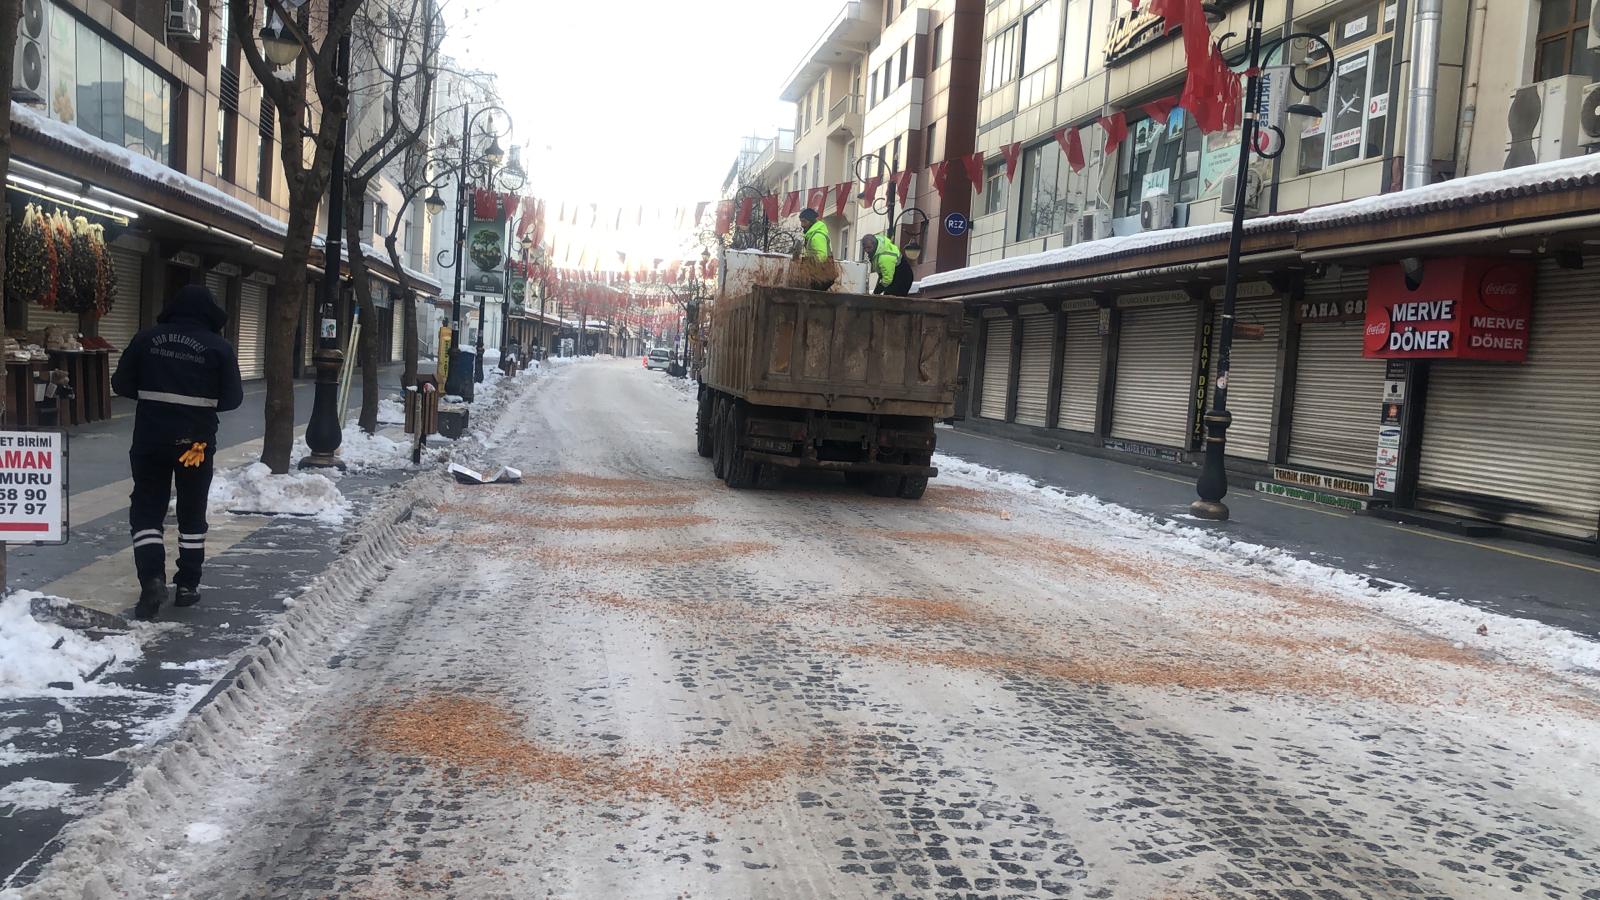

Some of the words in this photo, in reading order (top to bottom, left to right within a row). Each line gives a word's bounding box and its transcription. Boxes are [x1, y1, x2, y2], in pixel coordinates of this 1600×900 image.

[948, 220, 964, 229] REZ
[1301, 302, 1339, 318] TAHA
[1392, 300, 1453, 322] MERVE
[1473, 316, 1525, 330] MERVE
[1201, 325, 1211, 368] OLAY
[1390, 327, 1450, 351] DÖNER
[1472, 334, 1523, 350] DÖNER
[1195, 375, 1206, 433] DÖVİZ
[17, 435, 52, 447] BİRİMİ
[1275, 469, 1299, 481] TEKNİK
[1299, 473, 1321, 486] SERVİS
[1333, 482, 1370, 496] AKSESUAR
[24, 489, 47, 501] 90
[24, 503, 47, 515] 97
